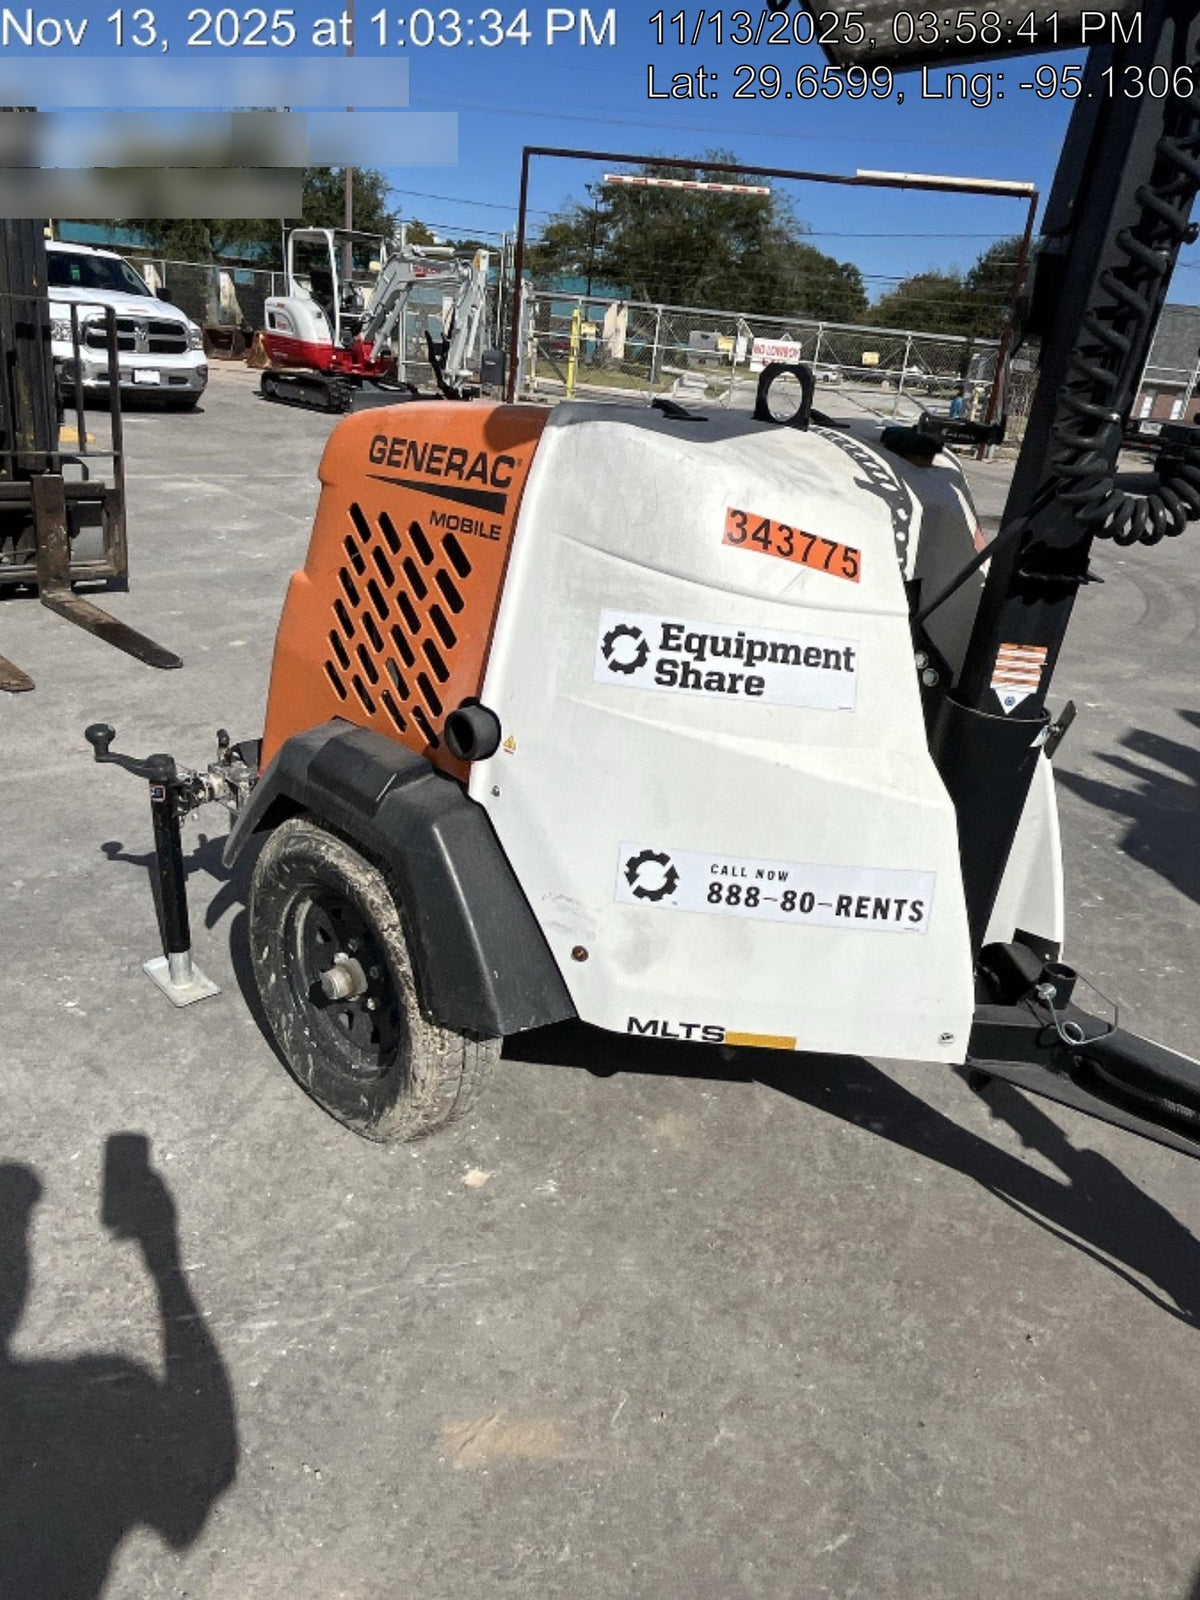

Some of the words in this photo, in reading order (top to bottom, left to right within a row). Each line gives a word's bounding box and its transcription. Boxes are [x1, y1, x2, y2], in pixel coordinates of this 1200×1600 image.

[369, 434, 516, 488] GENERAC
[429, 510, 502, 540] MOBILE
[726, 509, 859, 579] 343775
[659, 622, 856, 673] Equipment
[654, 658, 766, 696] Share
[710, 864, 748, 878] CALL
[755, 869, 789, 882] NOW
[707, 881, 925, 923] 888-80-RENTS
[627, 1016, 726, 1043] MLTS
